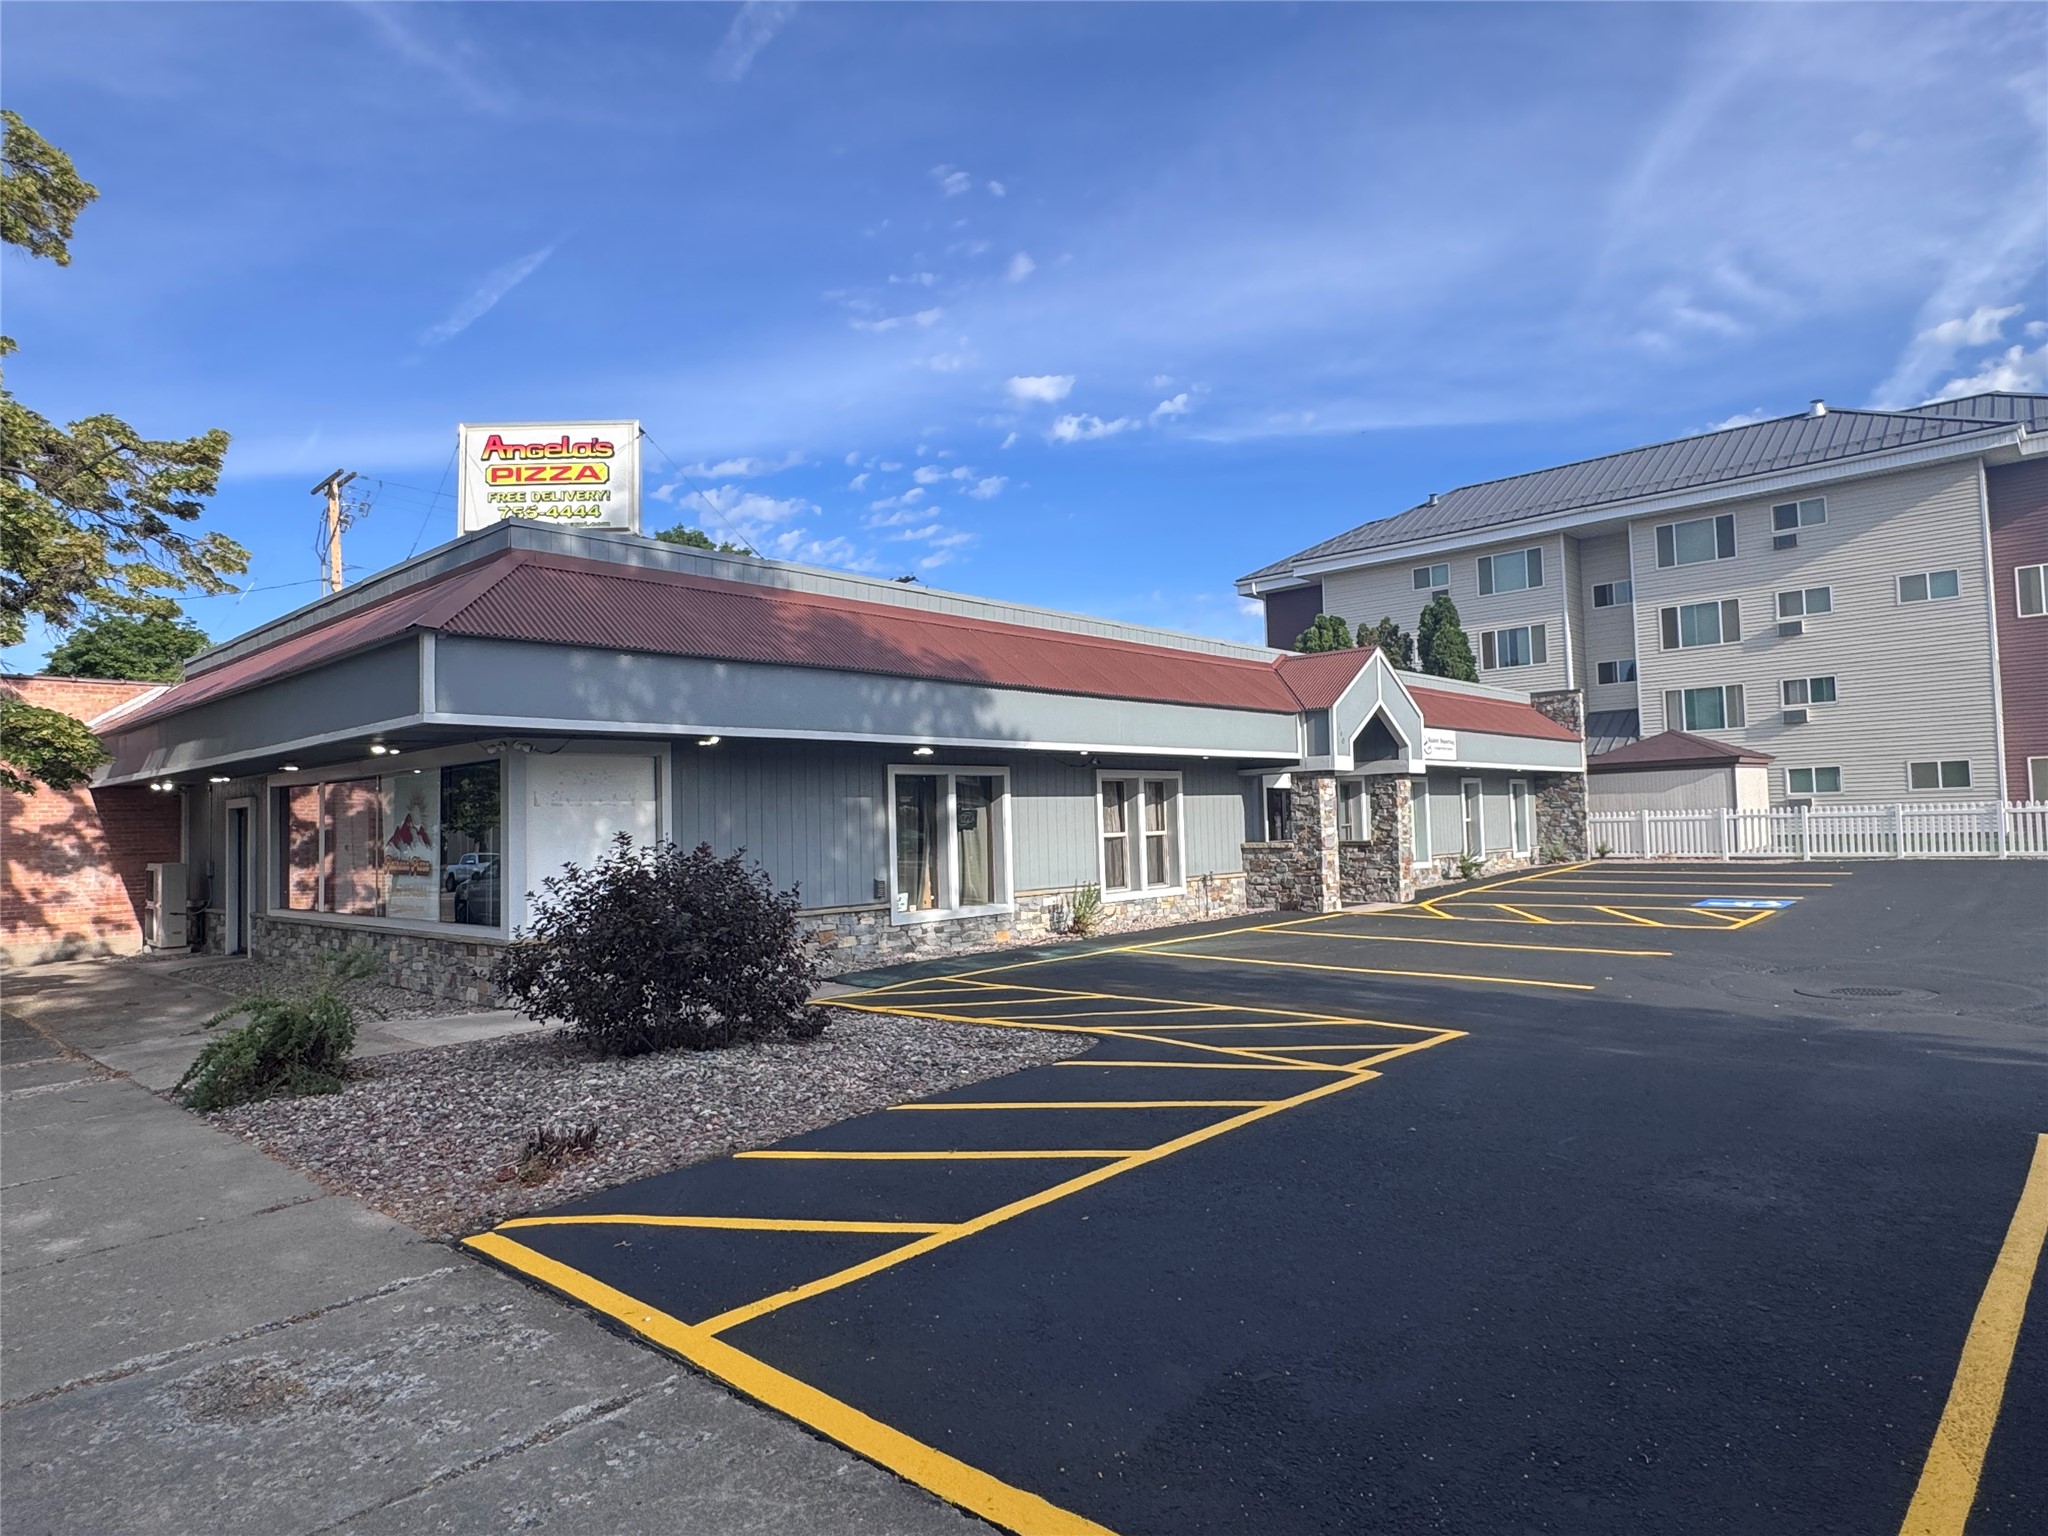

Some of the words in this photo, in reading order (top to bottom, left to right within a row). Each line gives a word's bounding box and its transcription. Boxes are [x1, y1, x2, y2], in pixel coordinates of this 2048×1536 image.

[490, 465, 603, 483] PIZZA
[487, 491, 527, 503] FREE
[530, 489, 611, 503] DELIVERY!
